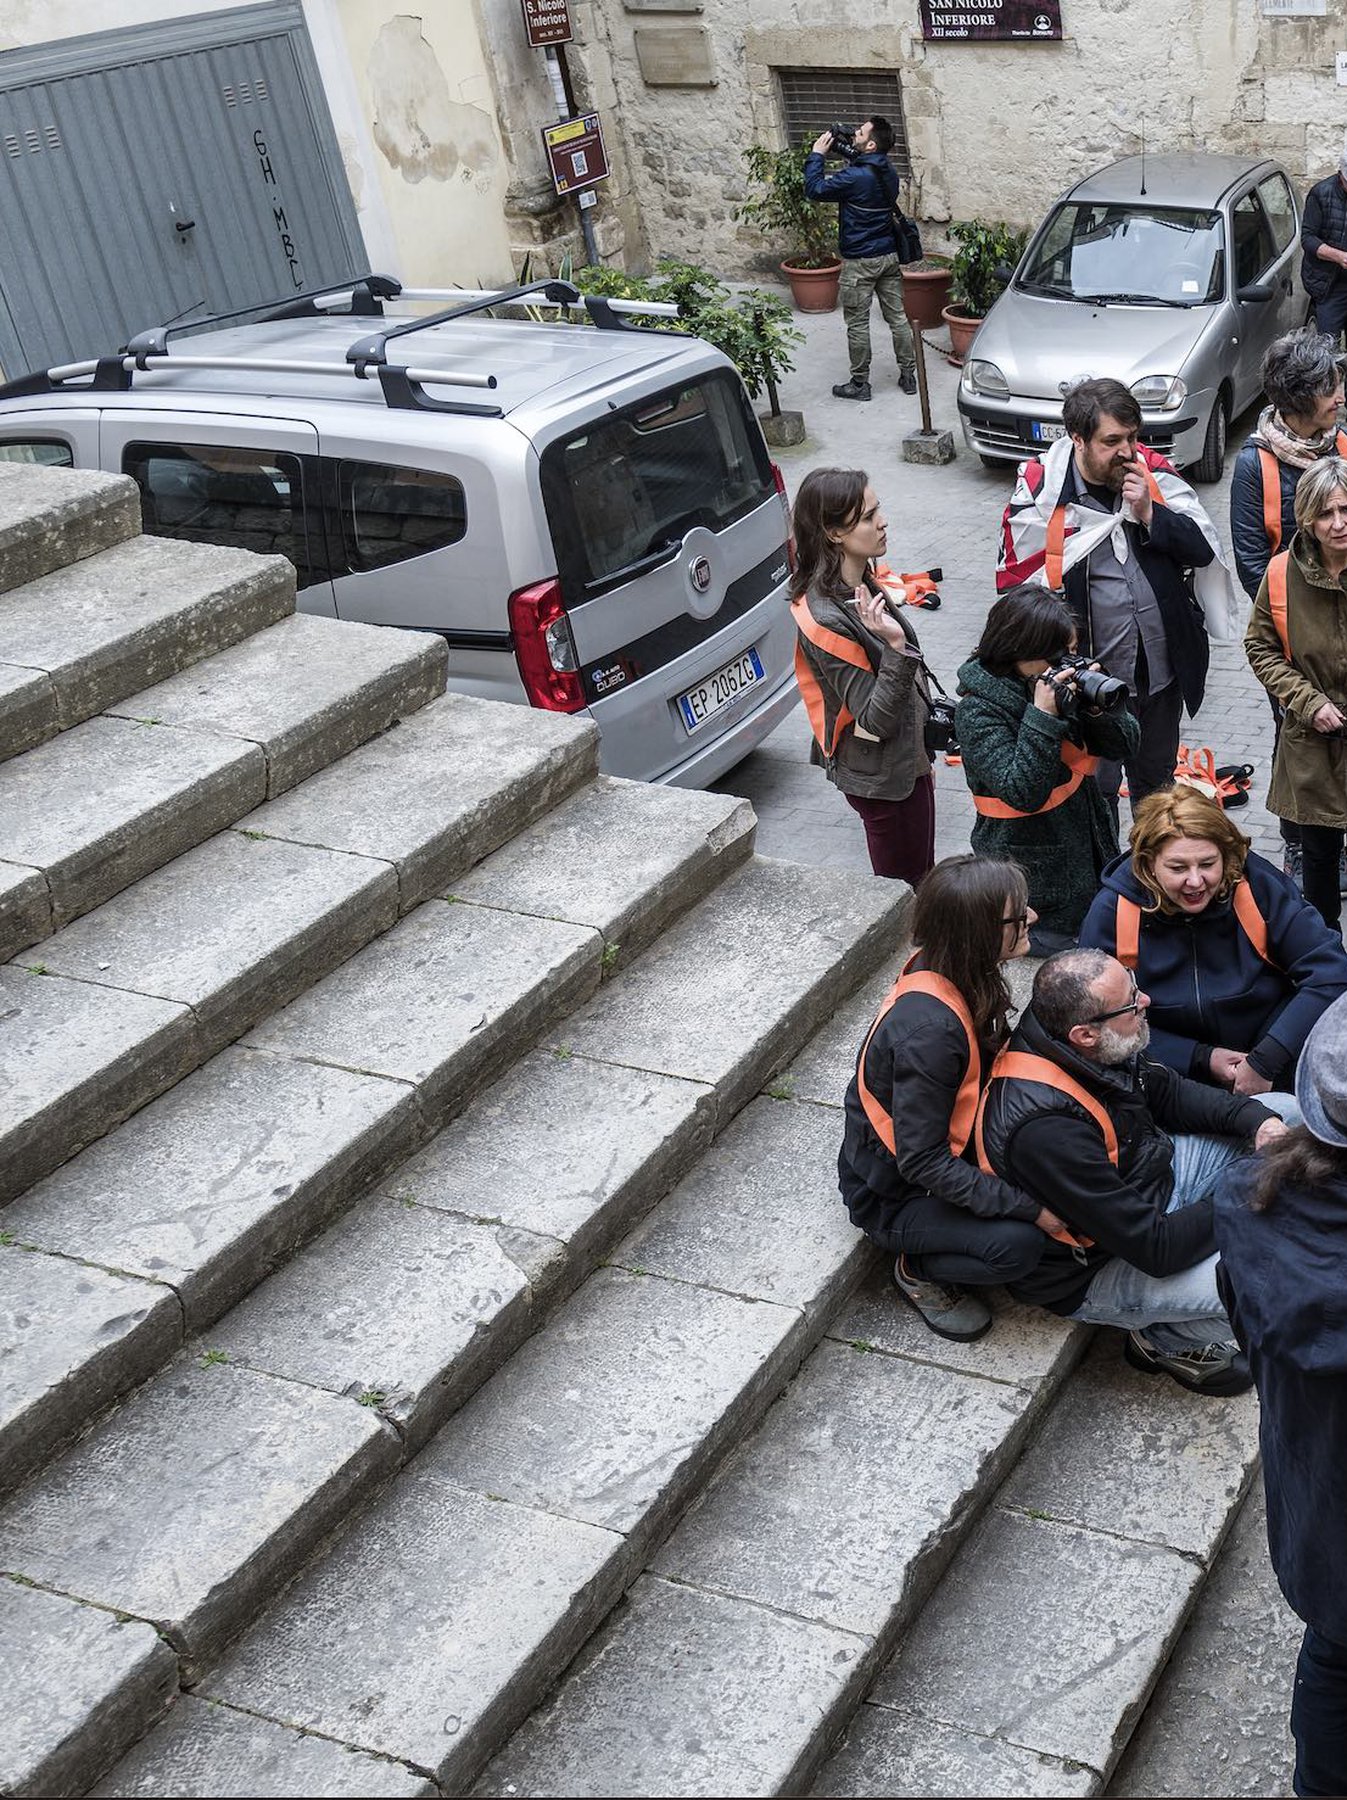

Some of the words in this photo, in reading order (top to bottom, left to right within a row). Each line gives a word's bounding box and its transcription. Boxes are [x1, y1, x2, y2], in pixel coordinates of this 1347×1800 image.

[526, 1, 537, 13] S.
[928, 0, 953, 9] SAN
[530, 13, 567, 27] Inferiore
[929, 11, 996, 26] INFERIORE
[931, 28, 944, 37] XII
[945, 27, 969, 37] secolo
